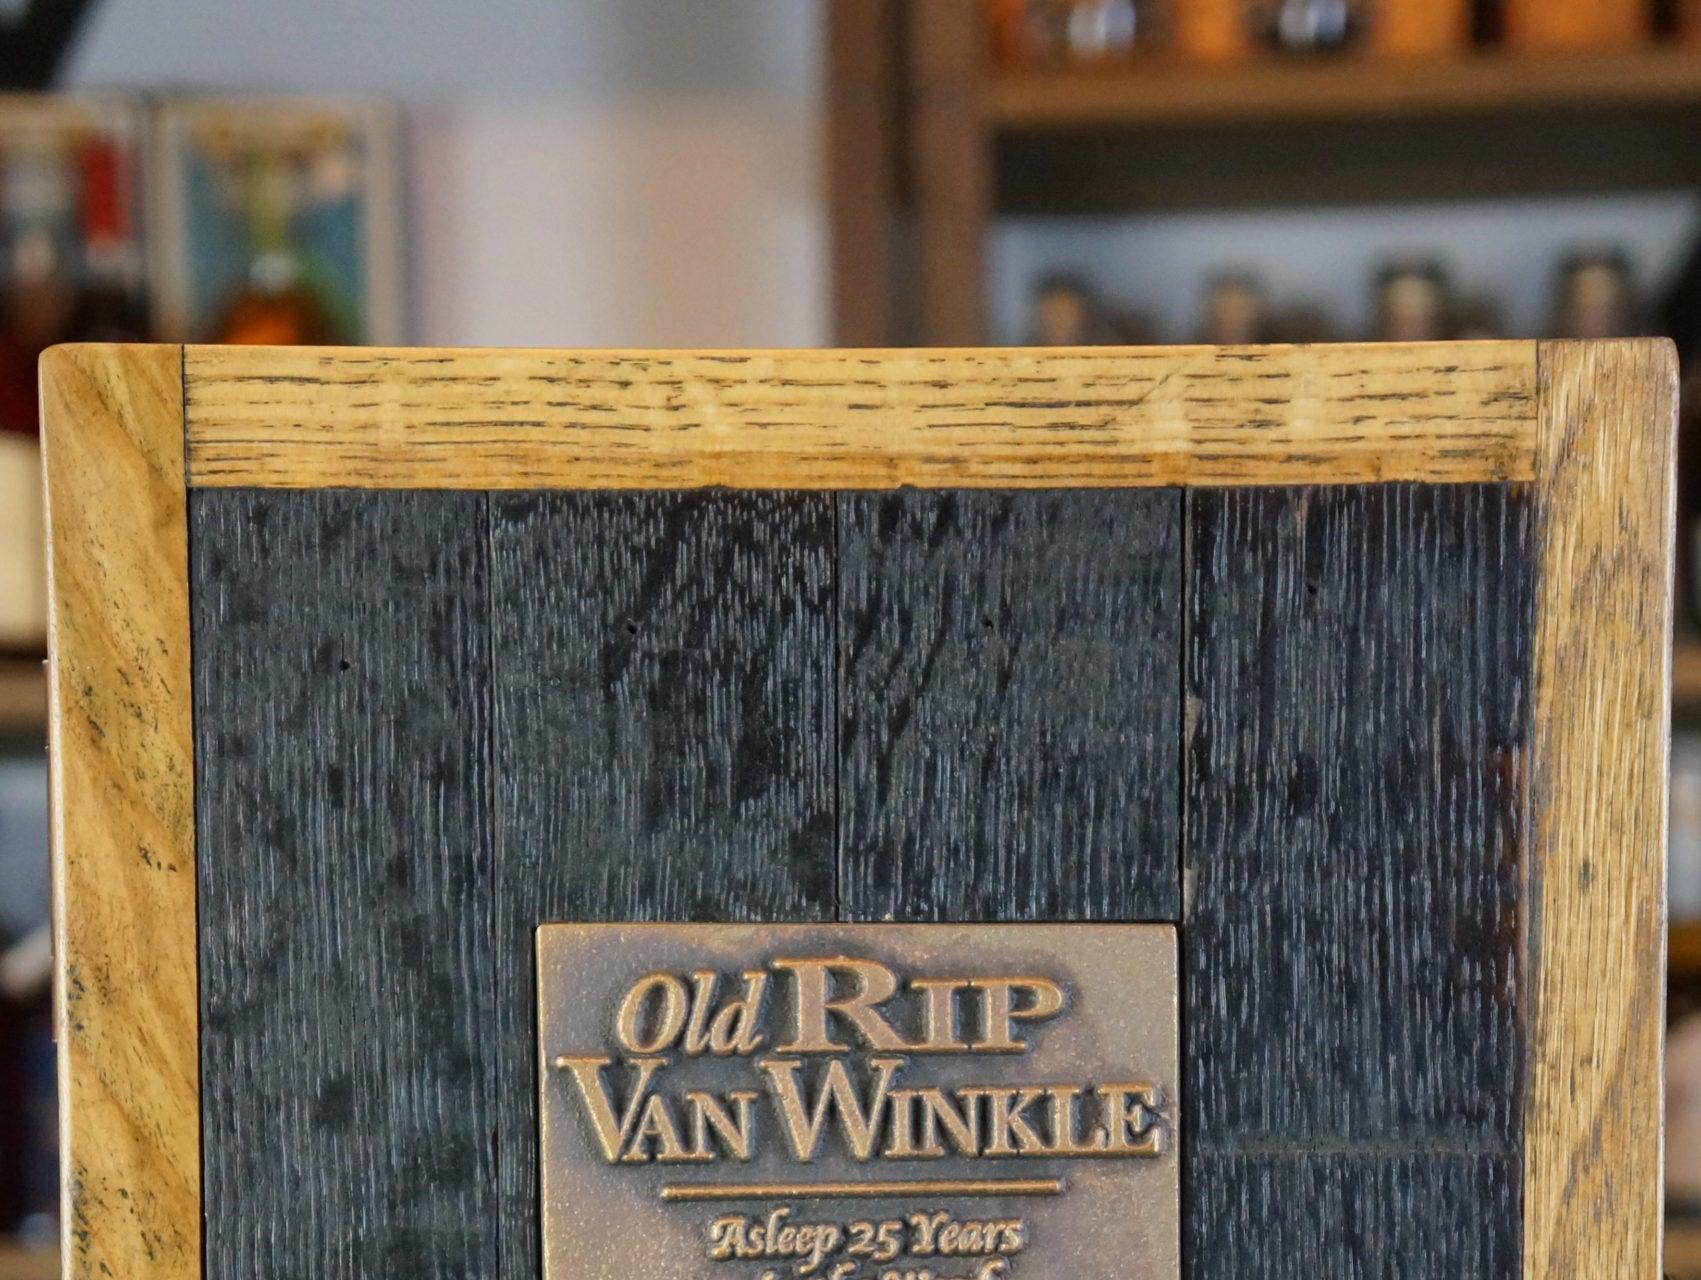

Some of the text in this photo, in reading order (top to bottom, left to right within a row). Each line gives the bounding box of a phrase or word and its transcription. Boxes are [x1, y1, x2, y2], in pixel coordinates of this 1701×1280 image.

[617, 956, 1063, 1055] Old RIP
[556, 1055, 1162, 1164] VAN WINKLE
[710, 1209, 1023, 1273] Asleep 25 Years
